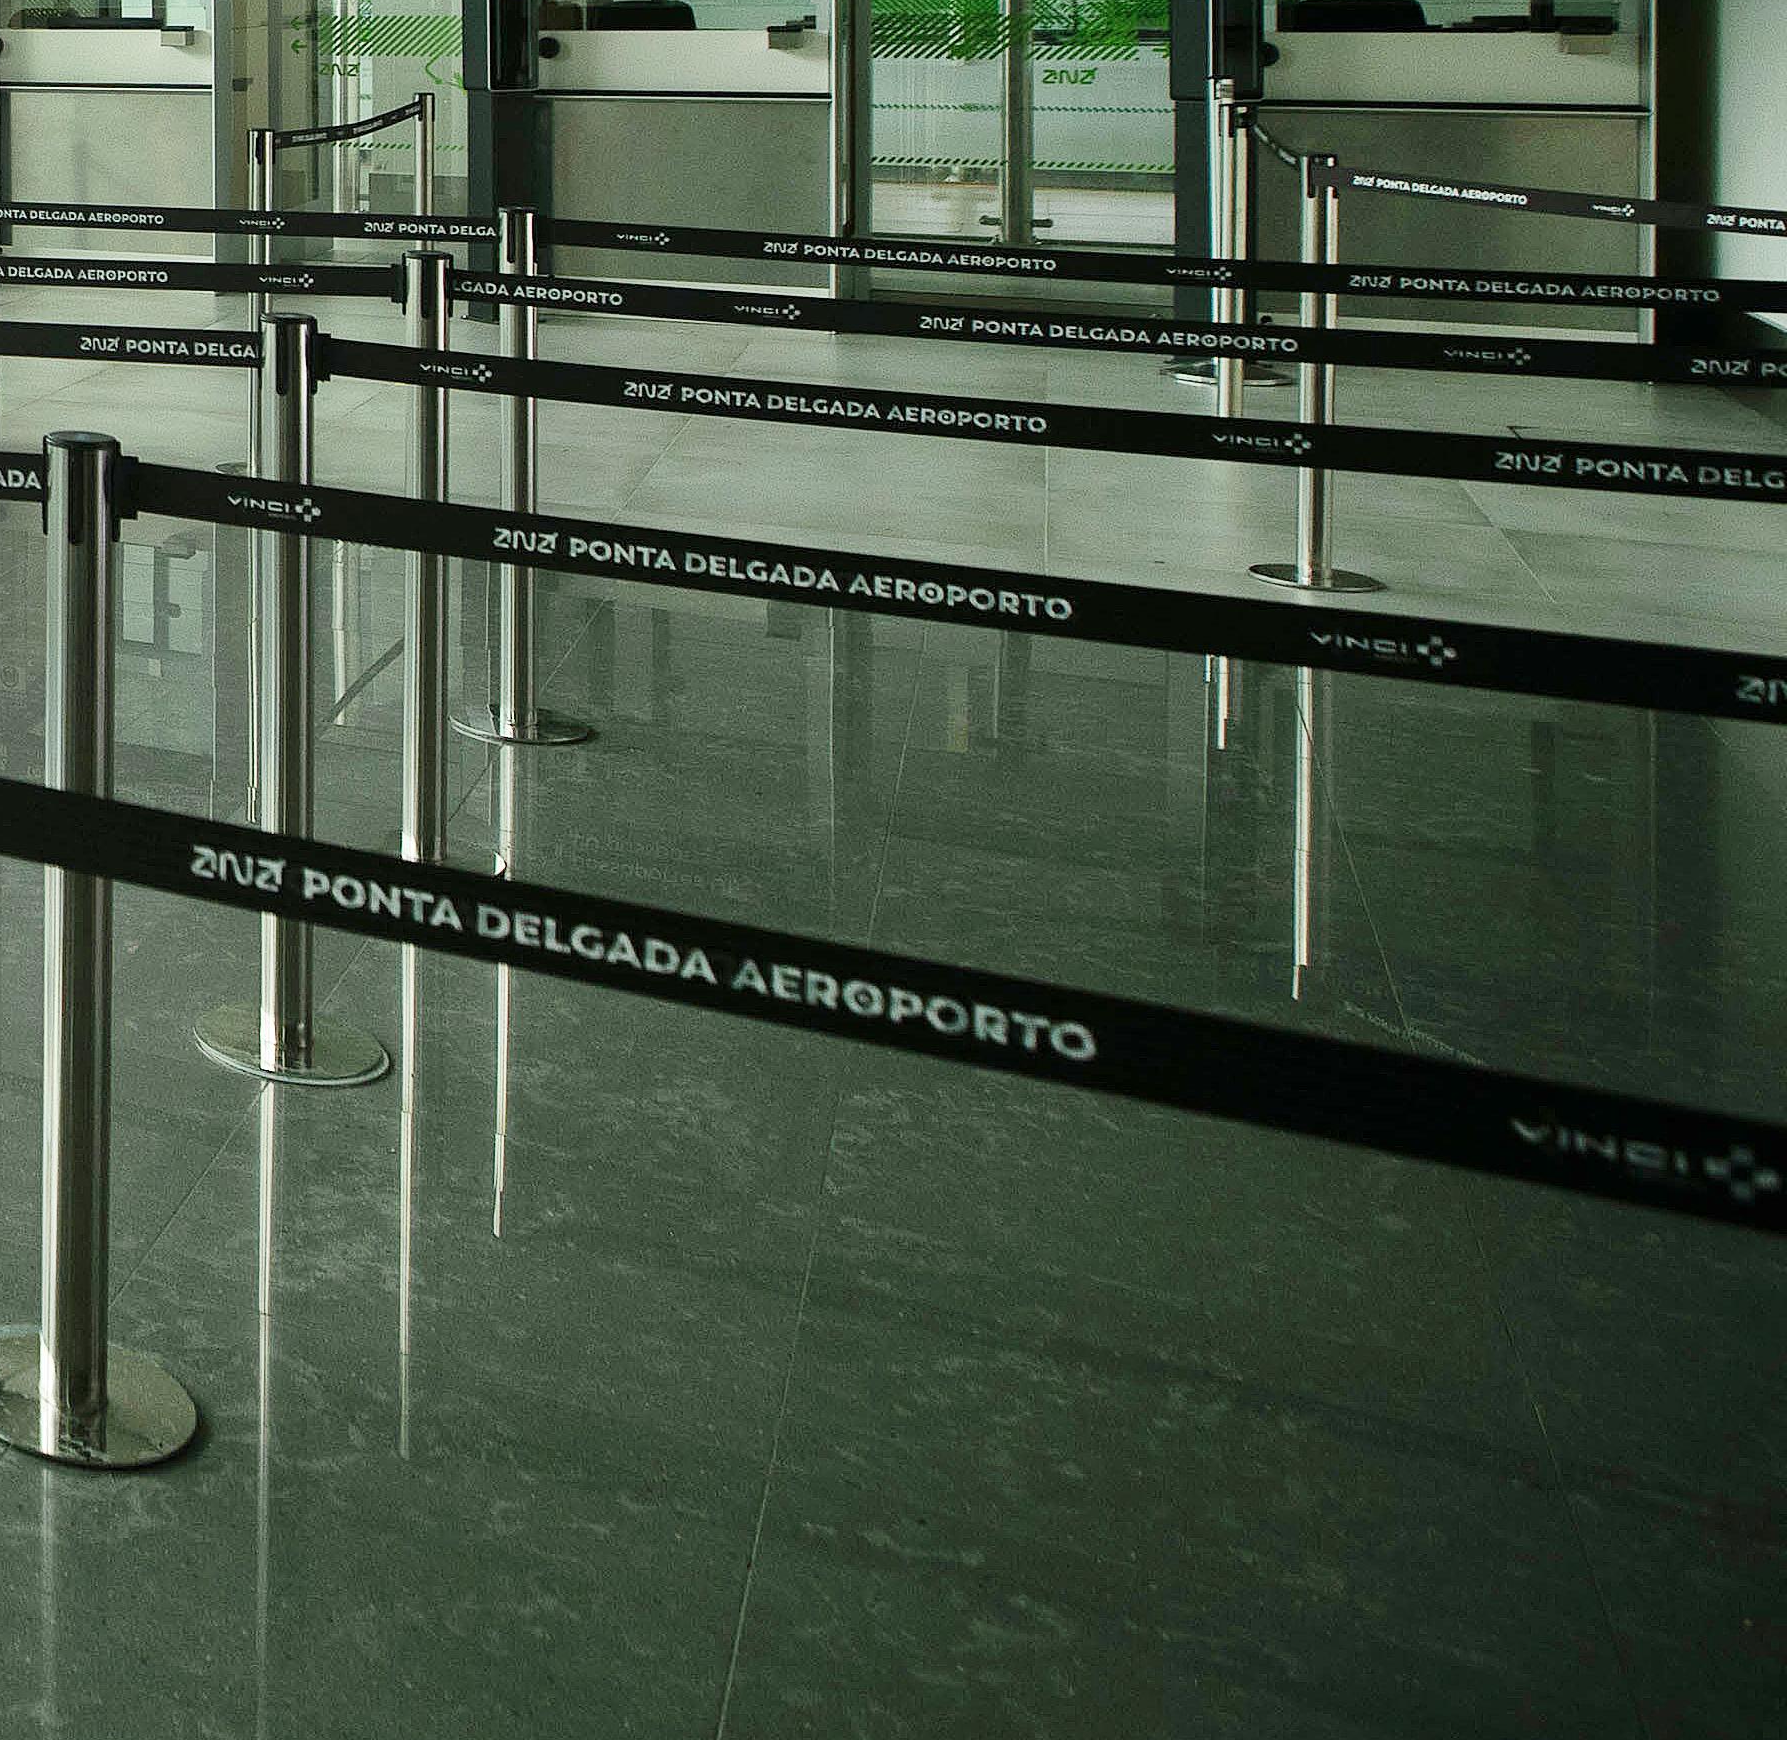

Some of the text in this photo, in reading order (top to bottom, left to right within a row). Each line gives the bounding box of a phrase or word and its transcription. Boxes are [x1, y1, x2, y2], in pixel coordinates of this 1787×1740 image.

[29, 210, 85, 221] DELGADA
[88, 212, 164, 224] AEROPORTO
[803, 244, 1056, 270] PONTA DELGADA AEROPORTO
[7, 266, 74, 279] DELGADA
[77, 269, 168, 282] AEROPORTO
[1400, 277, 1720, 301] PONTA DELGADA AEROPORTO
[125, 339, 258, 358] PONTA DELGA
[972, 319, 1043, 336] PONTA
[1049, 324, 1150, 343] DELGADA
[1157, 332, 1298, 351] AEROPORTO
[681, 387, 761, 408] PONTA
[767, 395, 881, 418] DELGADA
[886, 406, 1047, 432] AEROPORTO
[1575, 458, 1688, 482] PONTA
[1698, 466, 1784, 488] DELG
[569, 537, 676, 570] PONTA
[684, 553, 839, 590] DELGADA
[848, 575, 1072, 618] AEROPORTO
[302, 869, 462, 929] PONTA
[477, 906, 717, 982] DELGADA
[732, 963, 1095, 1057] AEROPORTO
